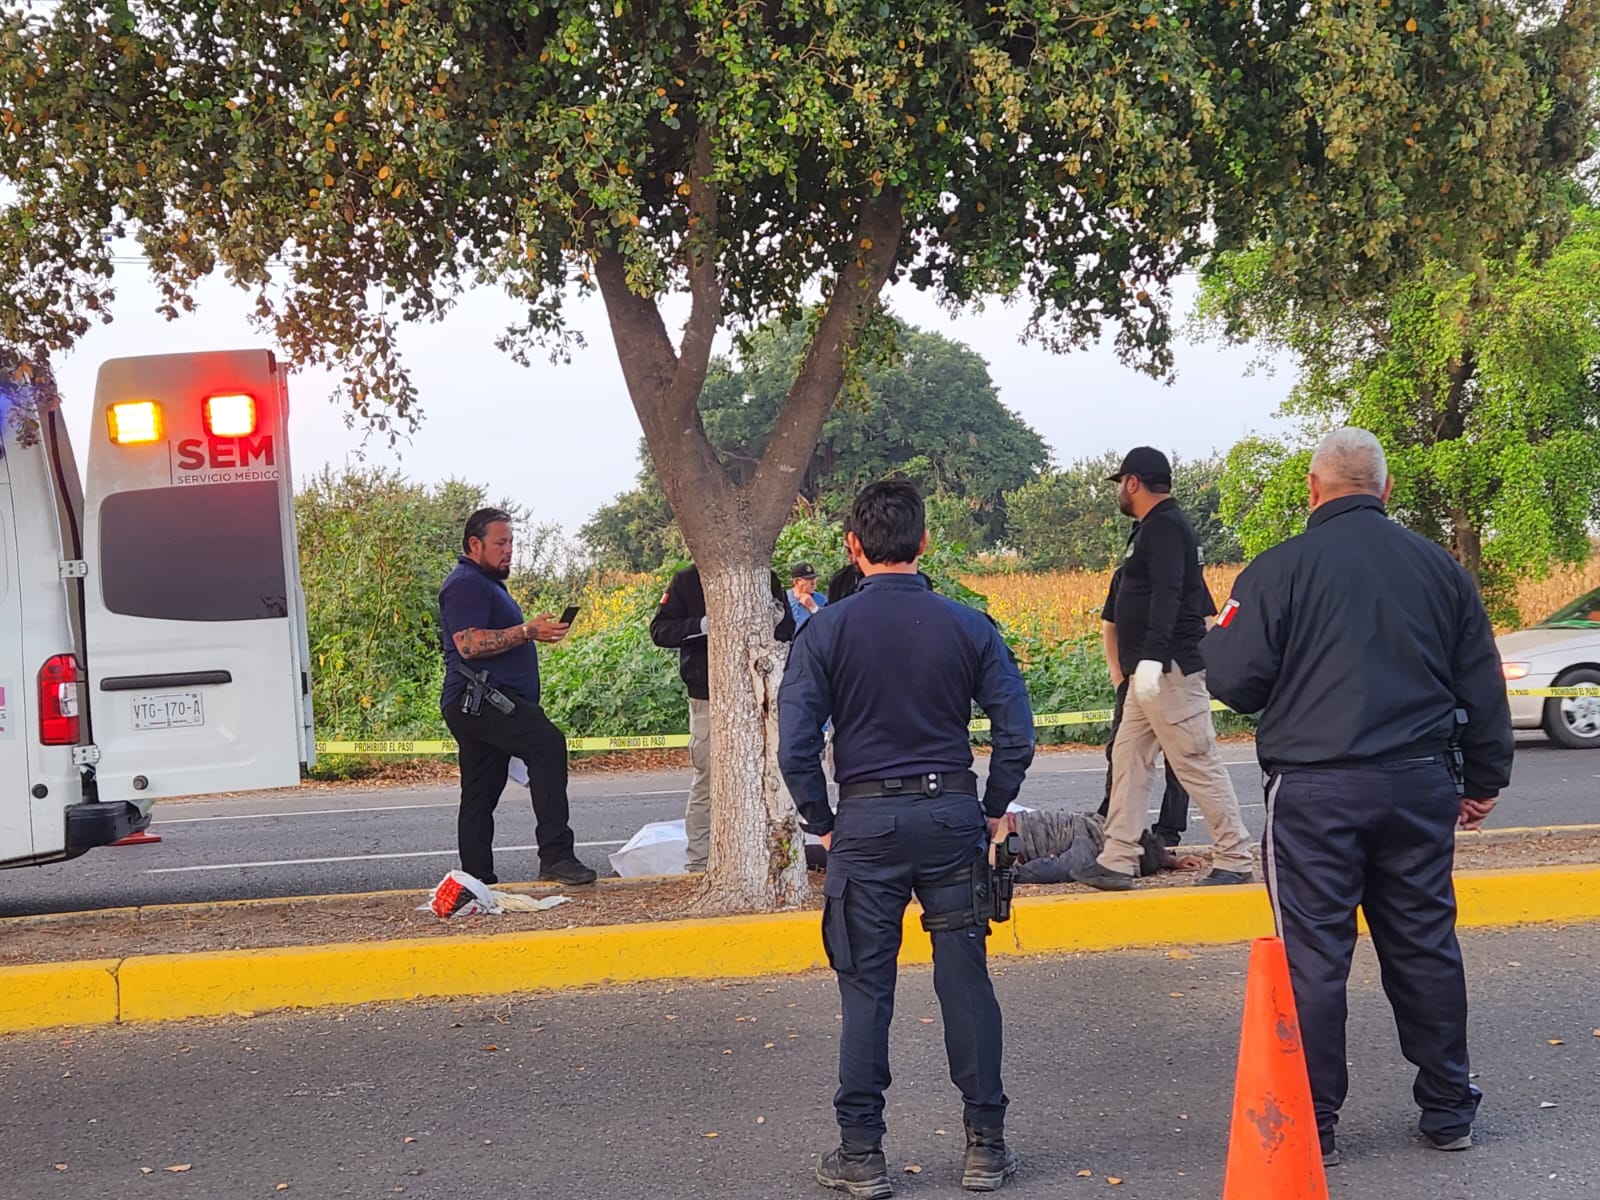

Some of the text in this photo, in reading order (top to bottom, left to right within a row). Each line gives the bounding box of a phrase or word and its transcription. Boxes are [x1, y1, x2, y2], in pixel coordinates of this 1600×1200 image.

[177, 436, 275, 470] SEM
[177, 474, 232, 485] SERVICIO
[134, 700, 200, 719] VTG-170-A
[354, 742, 414, 752] PROHIBIDO EL PASO
[568, 739, 582, 749] PASO
[642, 737, 649, 747] EL
[650, 736, 665, 746] PASO
